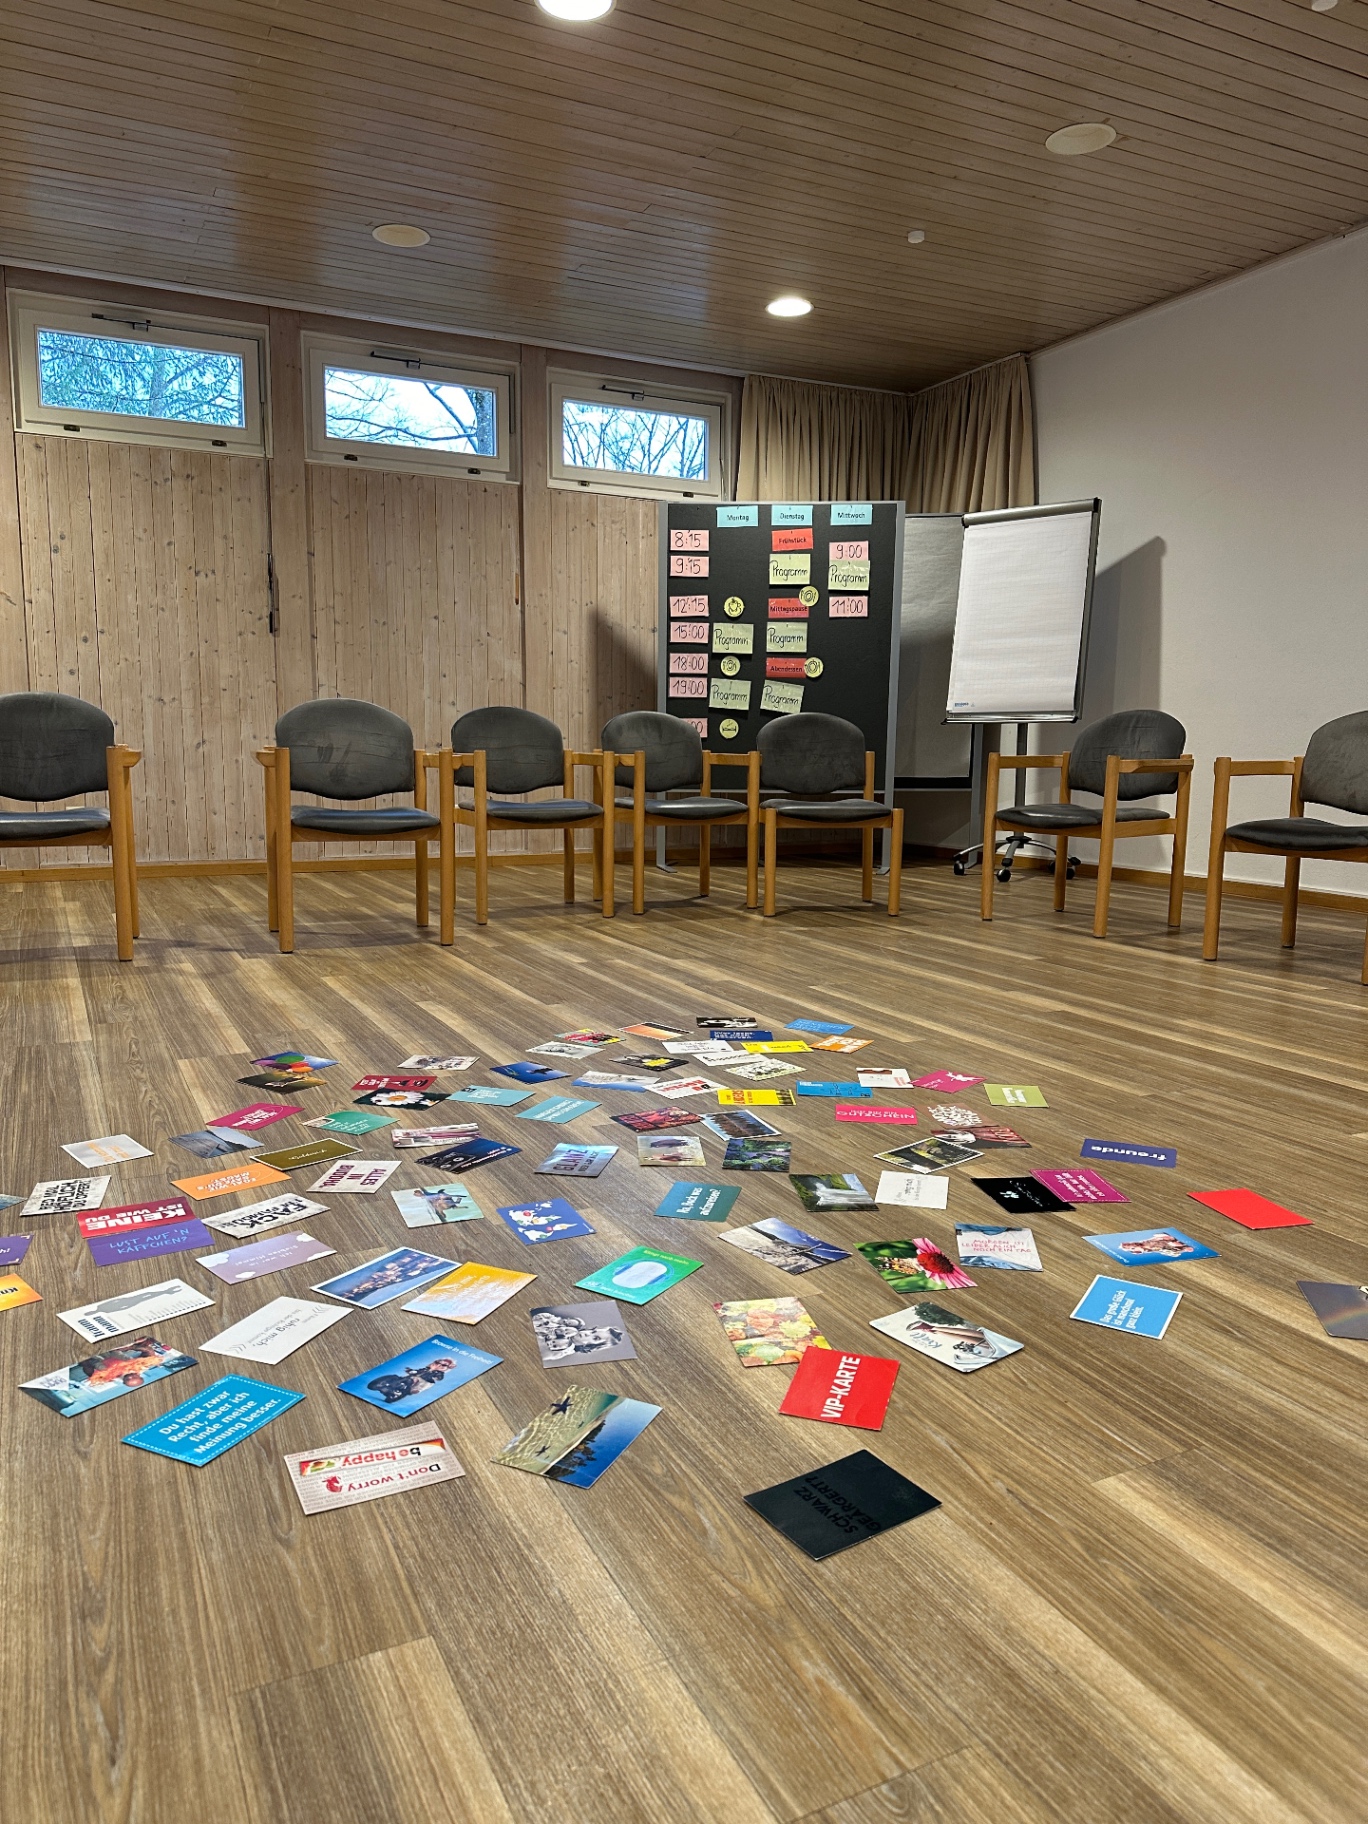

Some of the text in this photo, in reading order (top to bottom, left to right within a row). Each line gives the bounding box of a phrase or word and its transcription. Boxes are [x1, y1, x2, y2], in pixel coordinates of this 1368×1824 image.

[727, 514, 749, 522] Montag
[674, 531, 702, 548] 8:15
[836, 544, 863, 560] 9:00
[675, 557, 701, 574] 9:15
[769, 559, 808, 581] Programm
[829, 564, 868, 587] Programm
[673, 598, 706, 614] 12:15
[770, 605, 808, 613] Mittagspause
[832, 599, 864, 614] 11:00
[674, 625, 705, 639] 15:00
[714, 629, 749, 650] Programm
[767, 628, 804, 648] Programm
[673, 655, 705, 671] 18:00
[673, 680, 705, 695] 19:00
[711, 685, 748, 705] Programm
[763, 685, 799, 708] Programm
[553, 1149, 588, 1172] GLANZ
[1091, 1145, 1167, 1162] freunde
[349, 1173, 364, 1181] IN
[360, 1168, 387, 1186] ALLES
[85, 1204, 183, 1223] IST WIE DU
[85, 1208, 186, 1231] KEINE
[110, 1238, 140, 1249] LUST
[145, 1231, 170, 1242] AUF
[118, 1236, 188, 1254] KÄFFCHEN?
[1099, 1290, 1127, 1323] Das große Glück
[1117, 1298, 1135, 1319] manchmal
[252, 1317, 300, 1347] ruhig mich,
[1125, 1317, 1138, 1329] ganz
[910, 1331, 942, 1349] Kraft
[820, 1355, 861, 1418] VIP-KARTE
[159, 1390, 231, 1435] Du hast zwar
[168, 1391, 250, 1443] Recht, aber ich
[189, 1400, 257, 1443] finde meine
[194, 1398, 281, 1453] Meinung besser.
[342, 1446, 421, 1467] be happy
[347, 1463, 441, 1492] Don't worry
[793, 1486, 859, 1534] SCHWARZ
[805, 1475, 882, 1532] GEÄRGERT?
